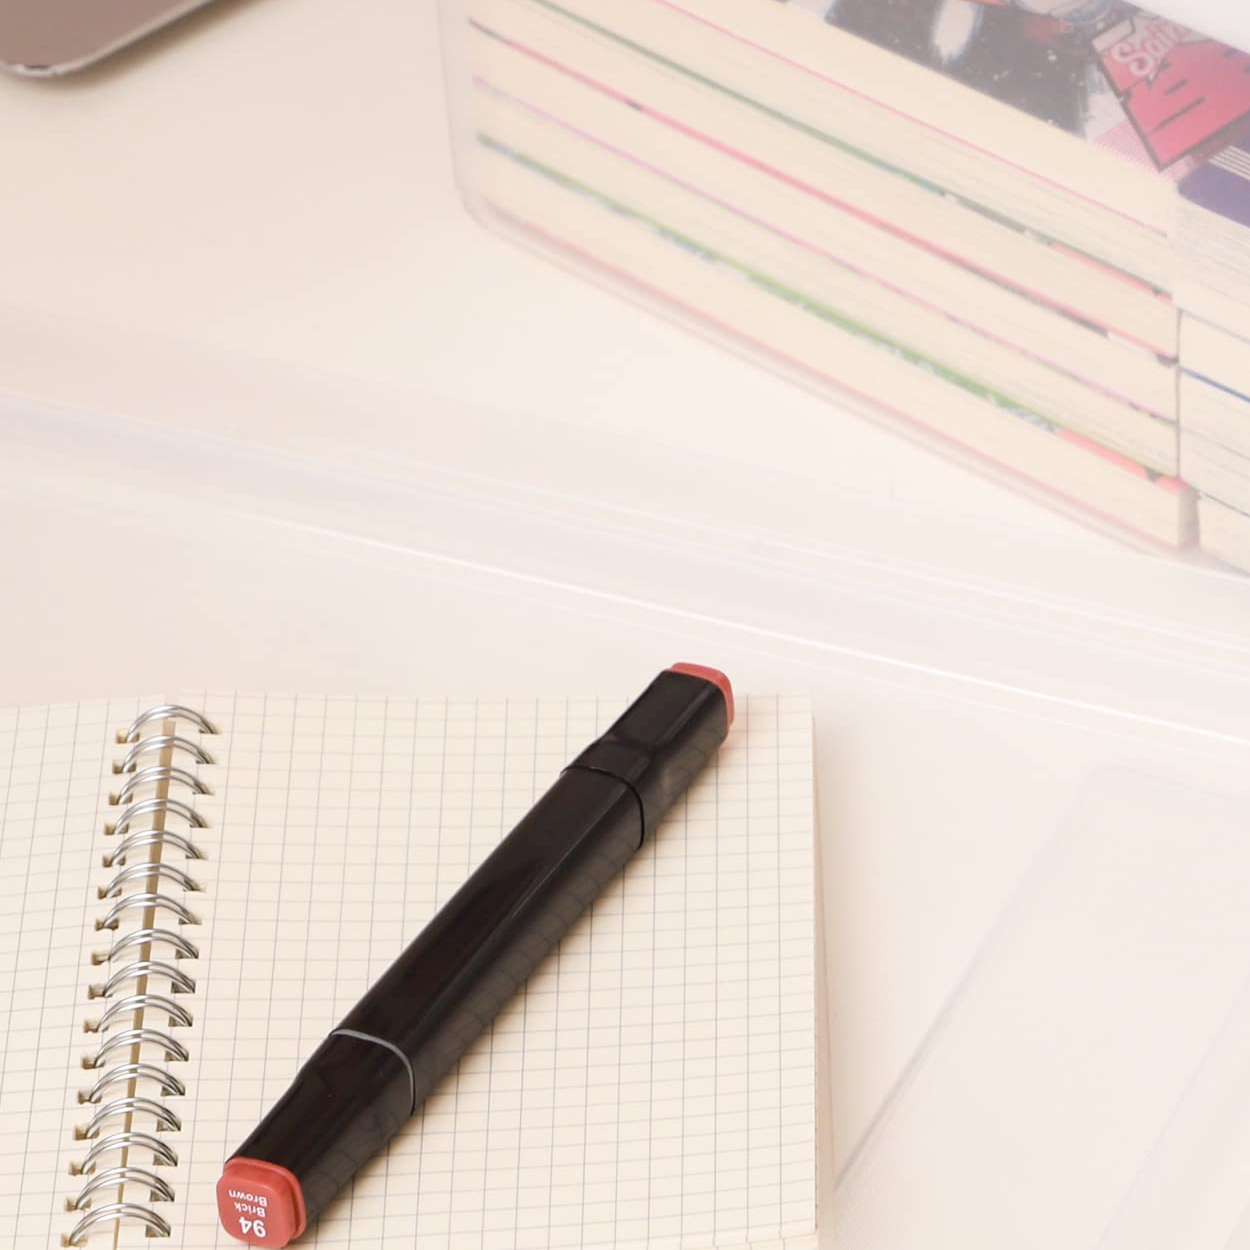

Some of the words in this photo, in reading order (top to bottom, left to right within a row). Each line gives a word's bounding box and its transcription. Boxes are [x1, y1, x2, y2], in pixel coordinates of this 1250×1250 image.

[228, 1189, 268, 1207] Brown
[234, 1201, 266, 1217] Brick
[239, 1216, 266, 1238] 94
